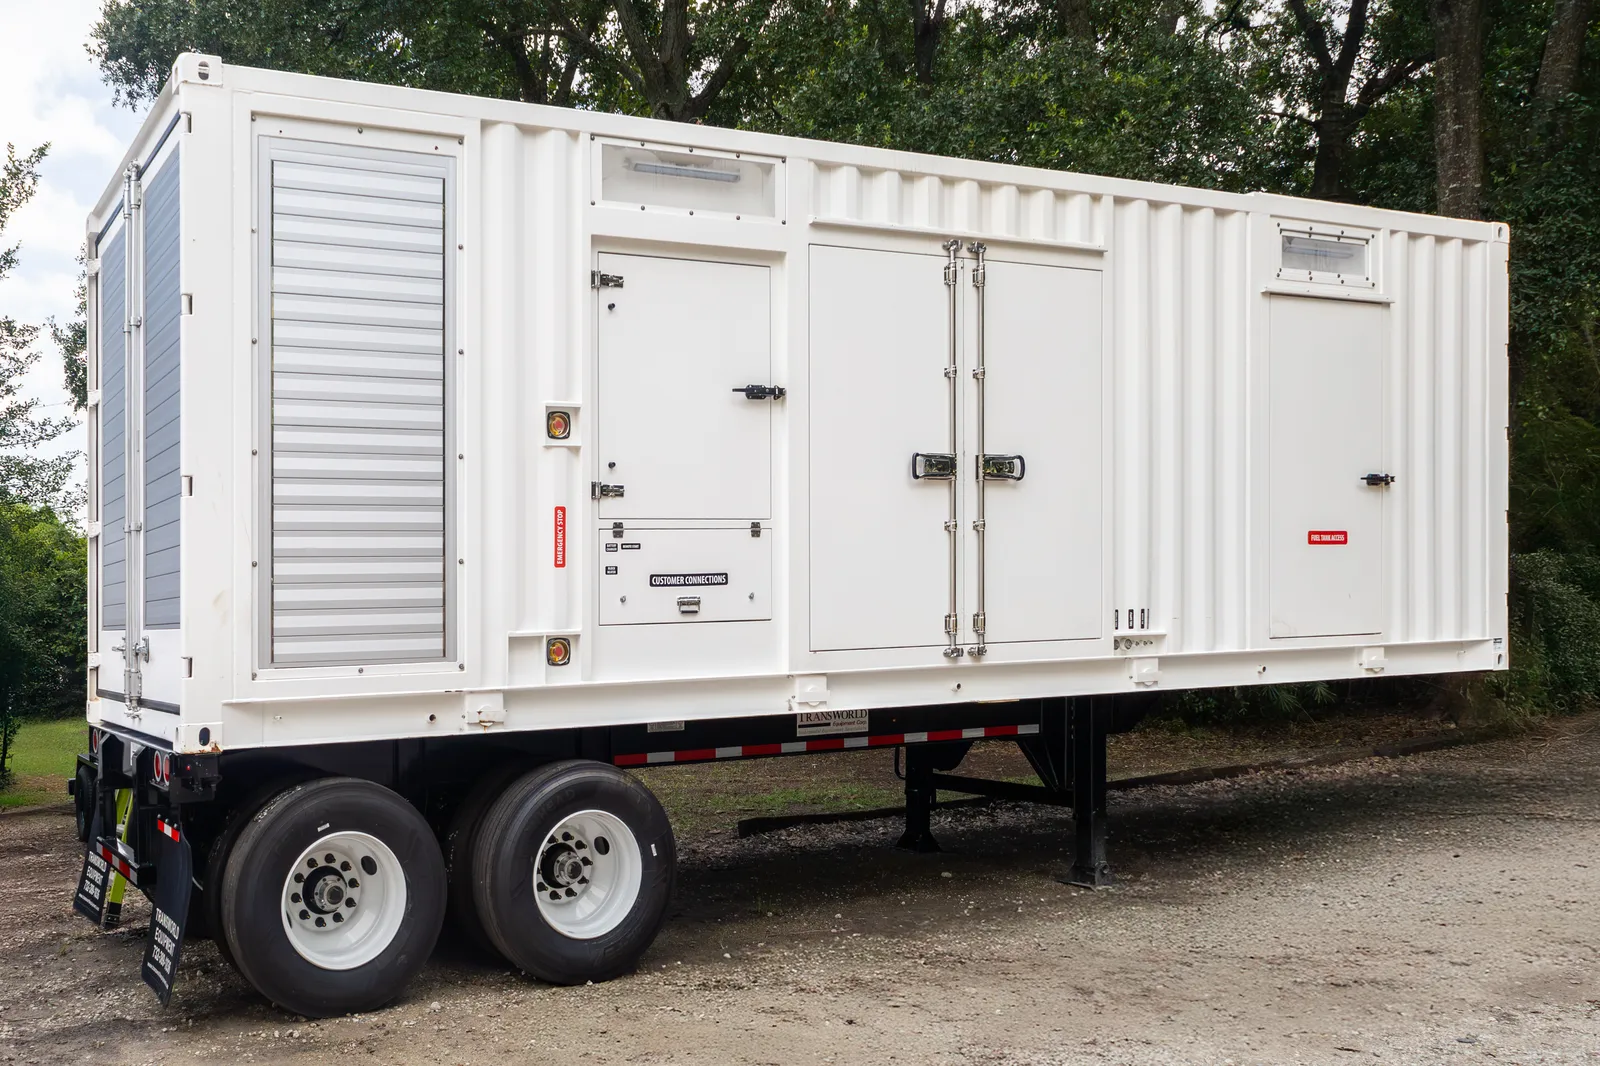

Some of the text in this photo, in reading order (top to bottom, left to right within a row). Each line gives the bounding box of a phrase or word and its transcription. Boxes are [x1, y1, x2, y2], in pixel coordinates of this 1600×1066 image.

[556, 509, 564, 565] EMERGENCY STOP
[652, 575, 726, 585] CUSTOMER CONNECTIONS
[800, 709, 868, 722] TRANSWORLD
